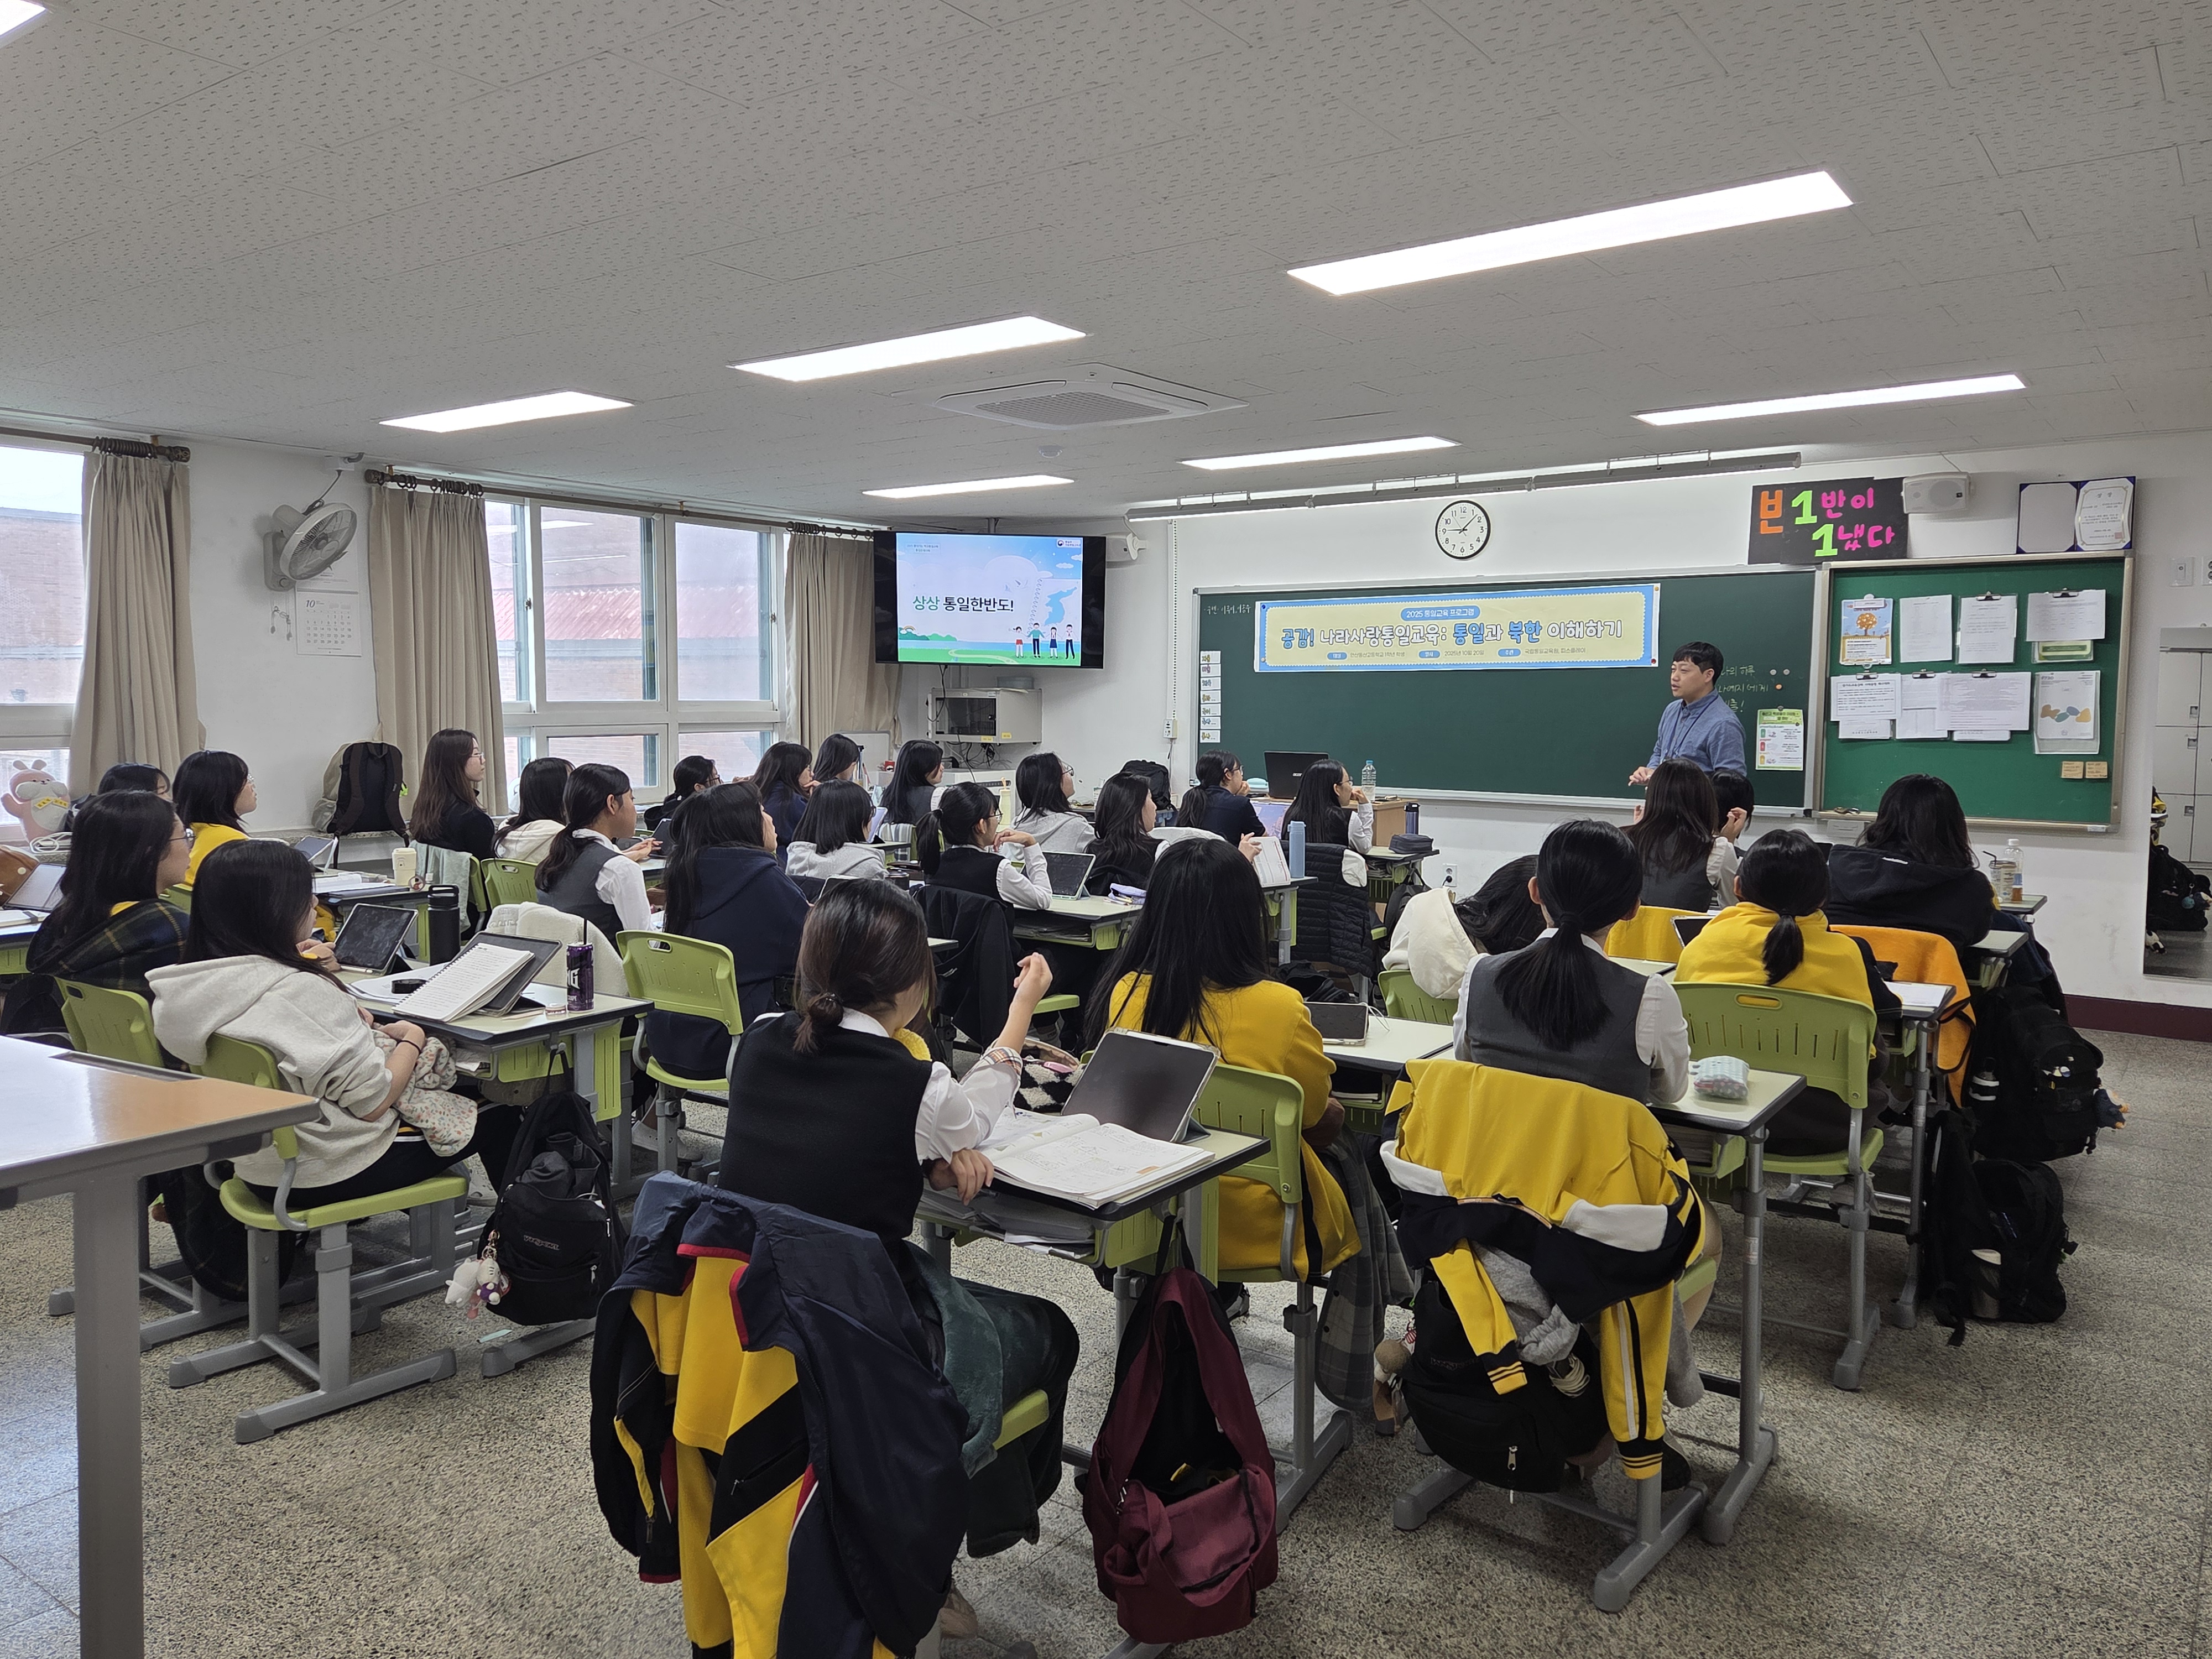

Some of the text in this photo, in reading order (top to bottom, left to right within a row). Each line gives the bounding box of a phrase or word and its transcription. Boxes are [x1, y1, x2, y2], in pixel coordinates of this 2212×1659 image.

[306, 599, 315, 608] 10
[912, 596, 1014, 612] 상상 통일한반도!
[1406, 610, 1423, 618] 2025
[1281, 619, 1623, 649] 공감! 나라사랑통일교육: 통일과 북한 이해하기
[1739, 665, 1756, 677] 하루
